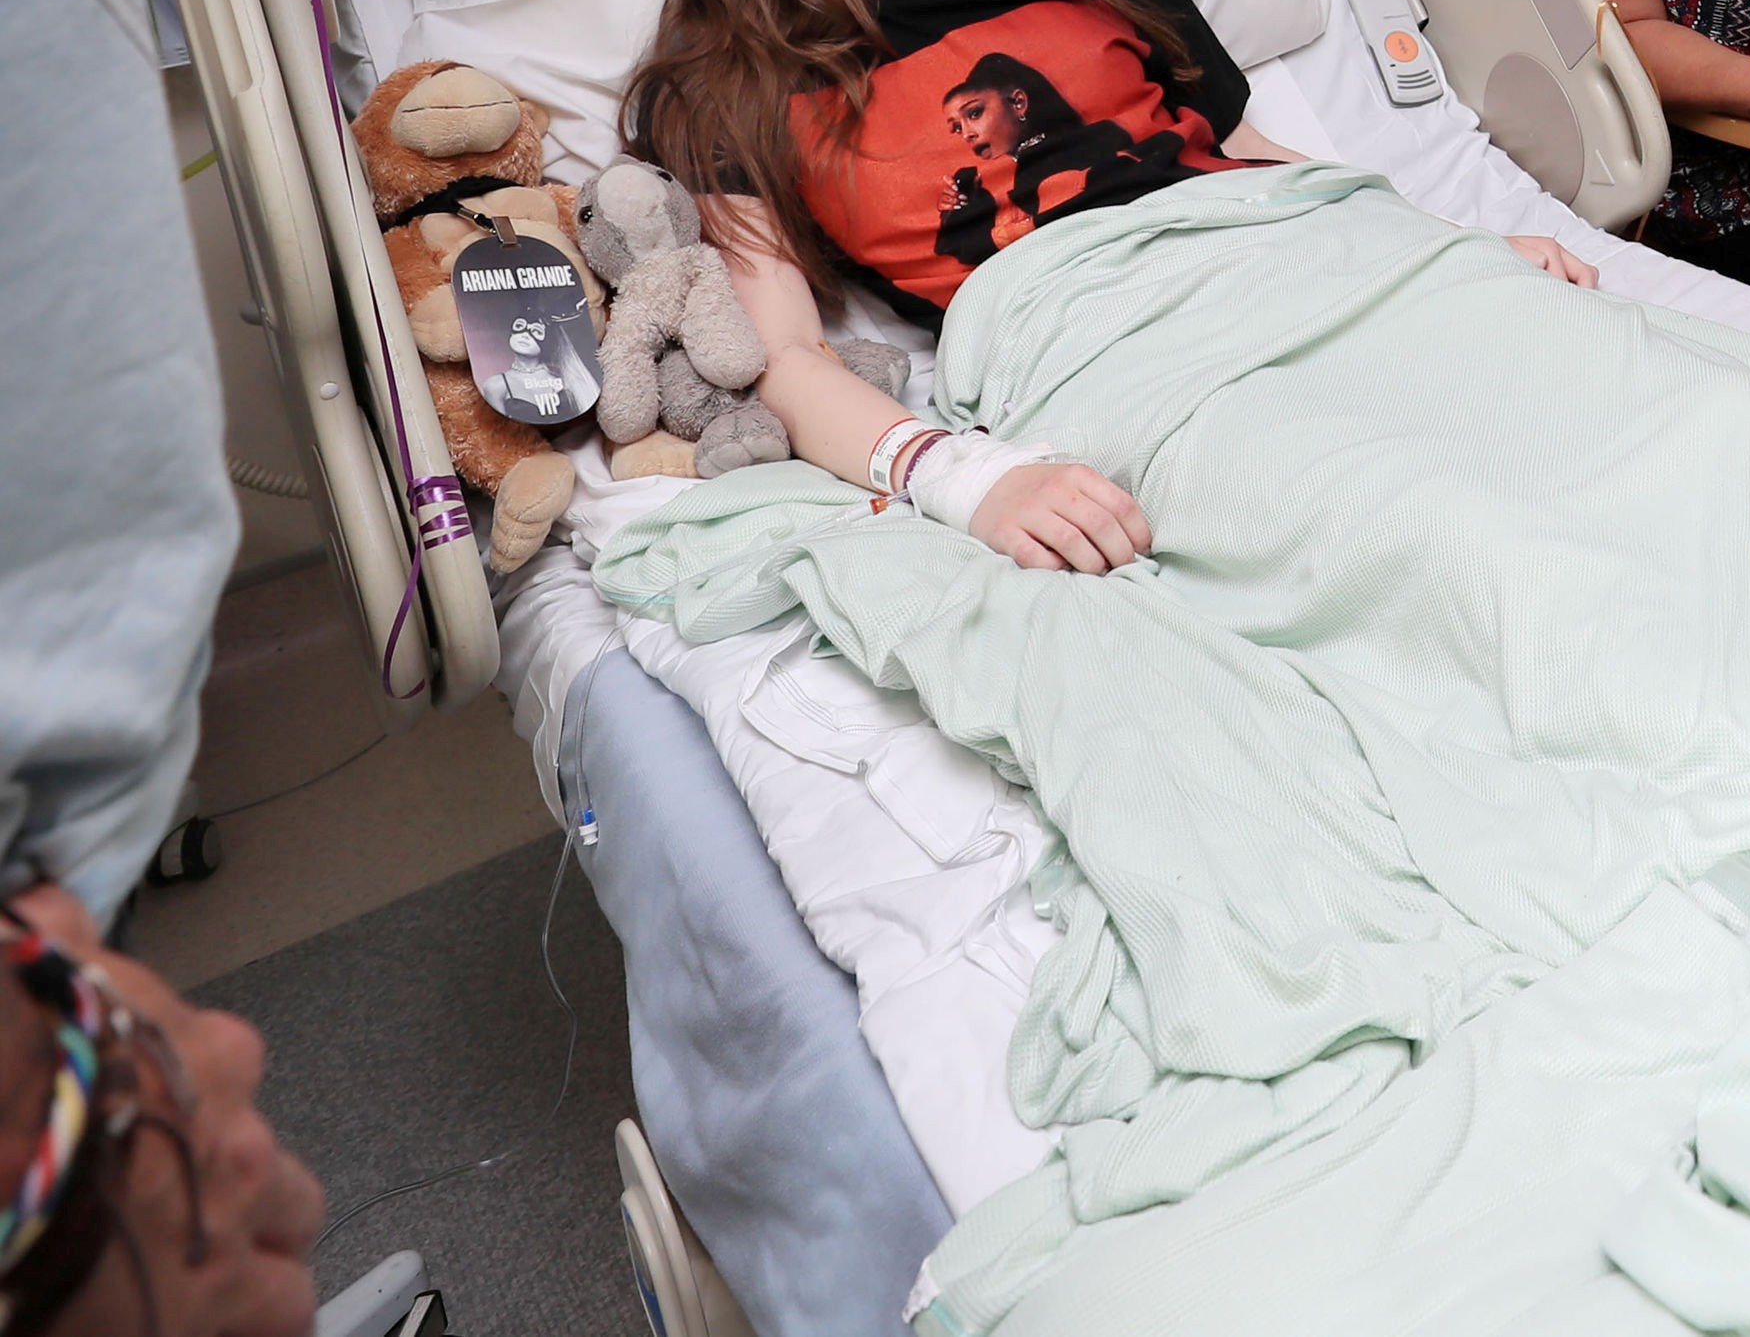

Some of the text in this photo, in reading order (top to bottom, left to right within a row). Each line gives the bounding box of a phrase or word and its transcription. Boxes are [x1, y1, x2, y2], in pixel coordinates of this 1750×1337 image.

[461, 265, 576, 292] ARIANA GRANDE
[524, 377, 564, 392] Bkstg
[534, 392, 561, 416] VIP
